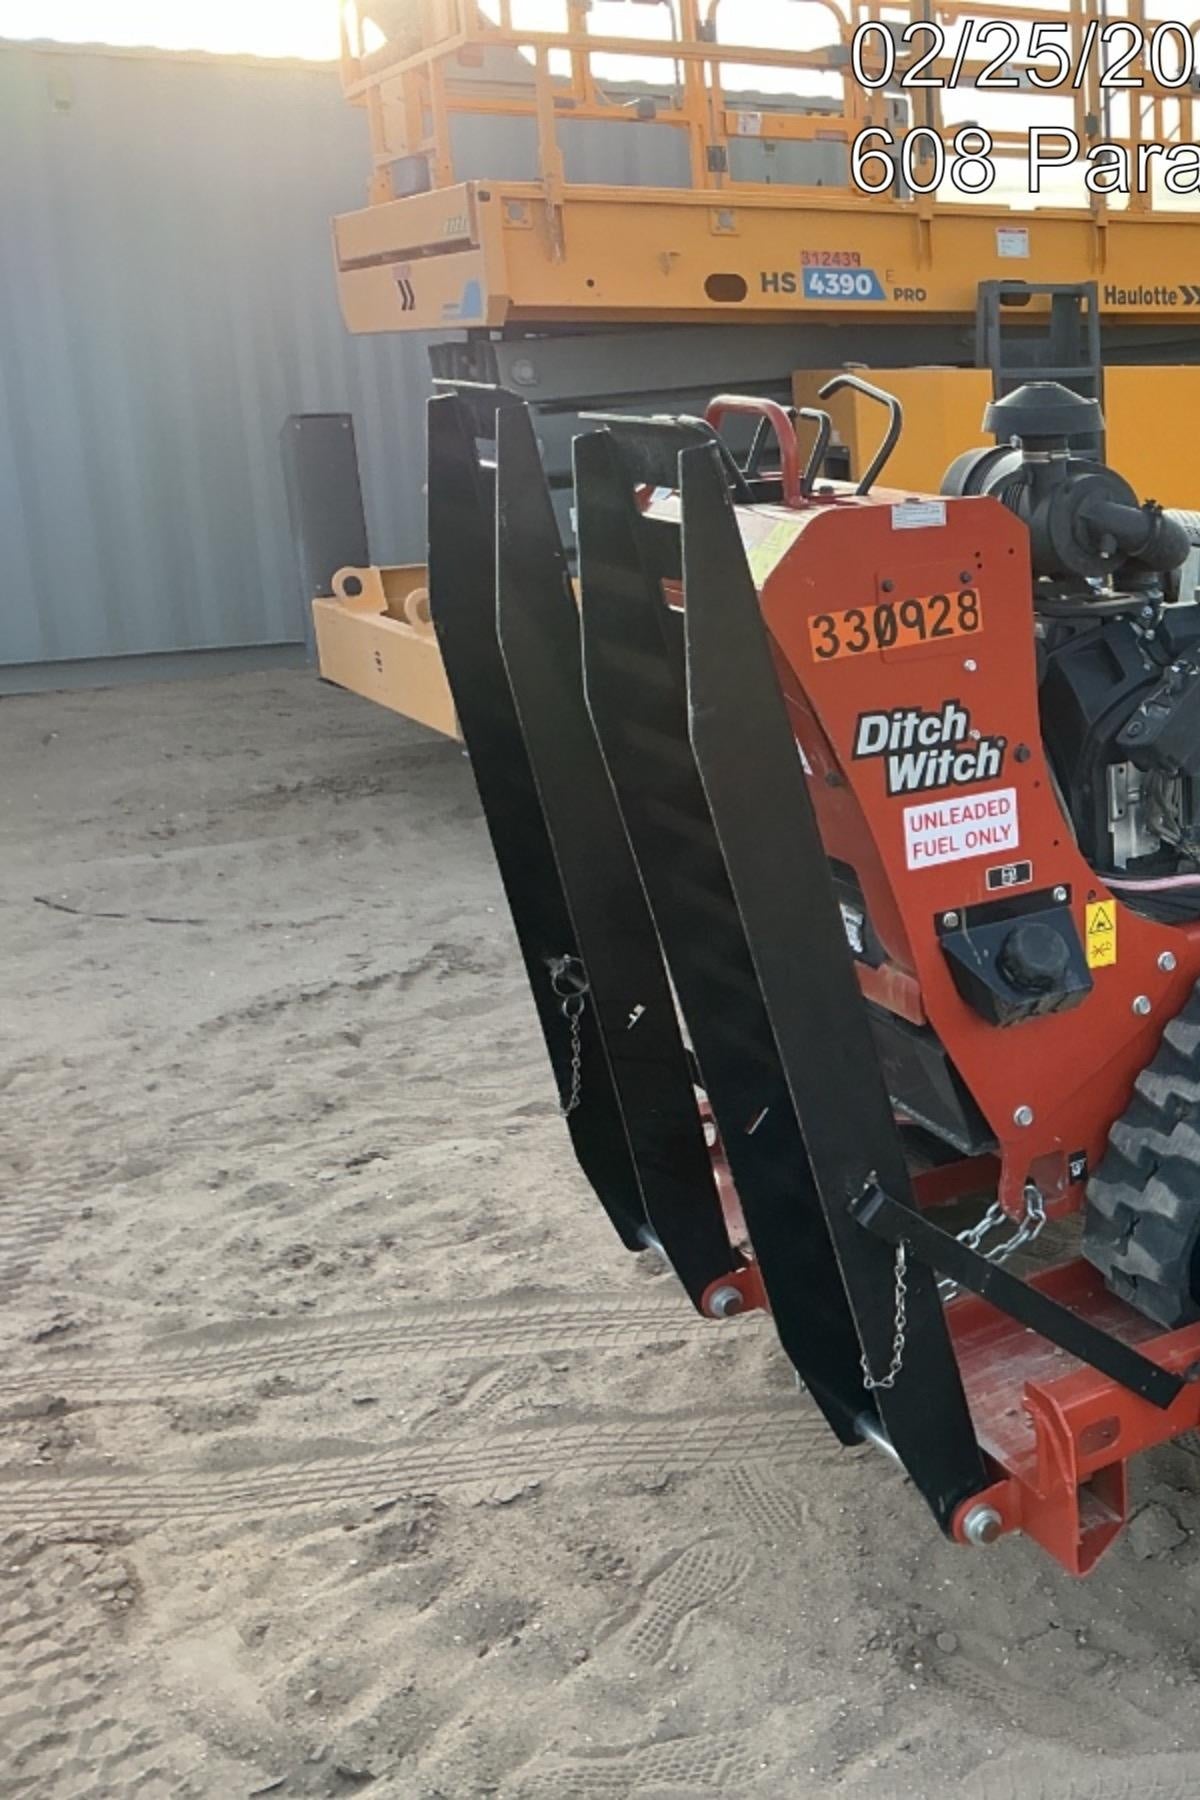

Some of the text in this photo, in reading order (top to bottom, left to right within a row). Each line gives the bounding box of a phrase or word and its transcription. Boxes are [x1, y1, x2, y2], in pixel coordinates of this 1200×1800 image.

[801, 251, 861, 268] 312439
[760, 271, 927, 301] HS 4390 PRO
[1103, 285, 1178, 305] Haulotte
[811, 589, 981, 659] 330928
[855, 703, 968, 757] Ditch
[888, 740, 1001, 793] Witch
[910, 797, 1012, 833] UNLEADED
[912, 824, 1012, 860] FUEL ONLY
